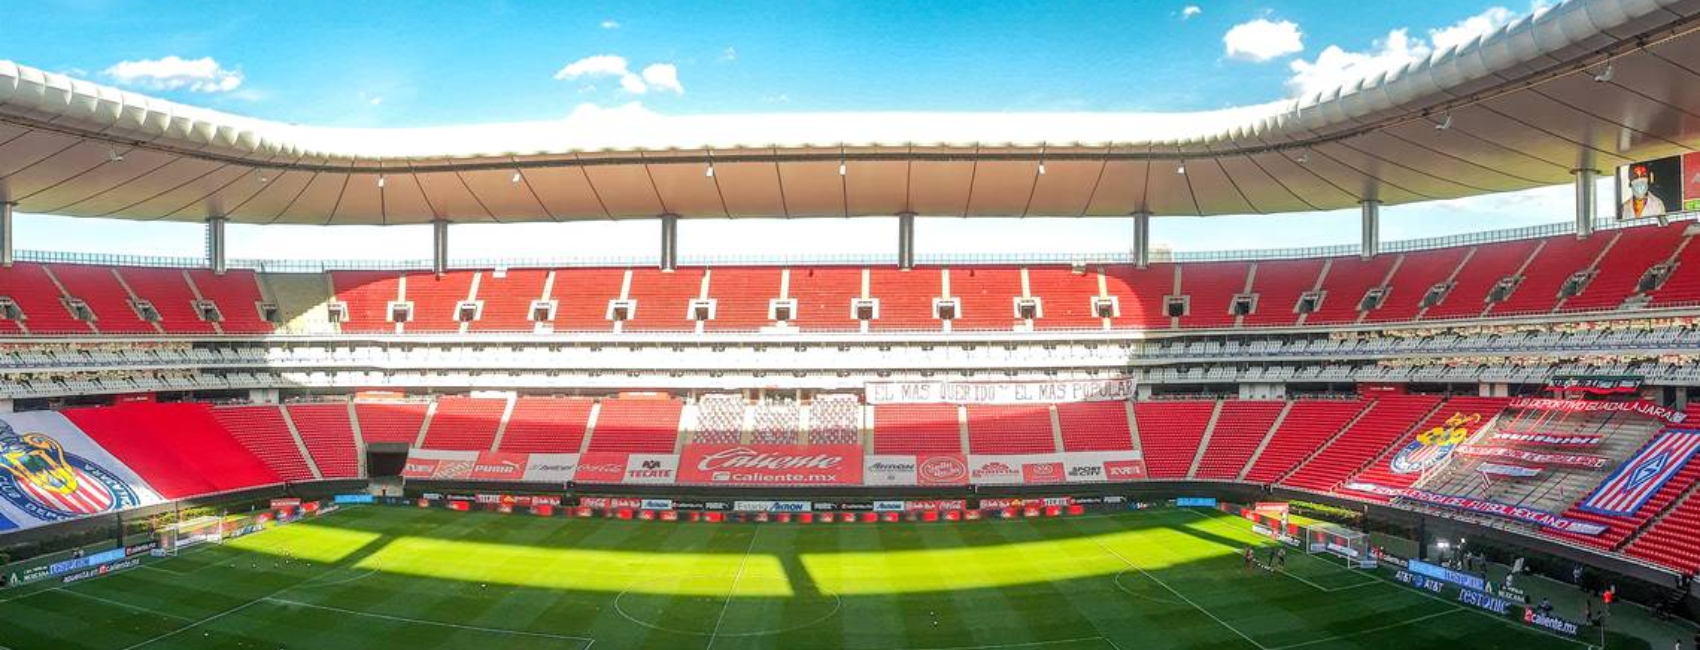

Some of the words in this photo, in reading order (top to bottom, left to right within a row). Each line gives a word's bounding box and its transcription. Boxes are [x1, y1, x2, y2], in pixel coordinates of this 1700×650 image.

[875, 383, 895, 401] EL
[902, 383, 930, 401] MAS
[940, 384, 997, 401] QUERIDO
[1015, 384, 1035, 401] EL
[1039, 383, 1067, 400] MAS
[1073, 377, 1134, 399] POPULAR
[1586, 400, 1674, 420] GUADALAJARA
[696, 446, 844, 471] Caliente
[629, 469, 672, 479] TECATE
[732, 472, 837, 482] caliente.mx
[1423, 580, 1444, 593] AT&T
[1532, 613, 1578, 635] caliente.mx
